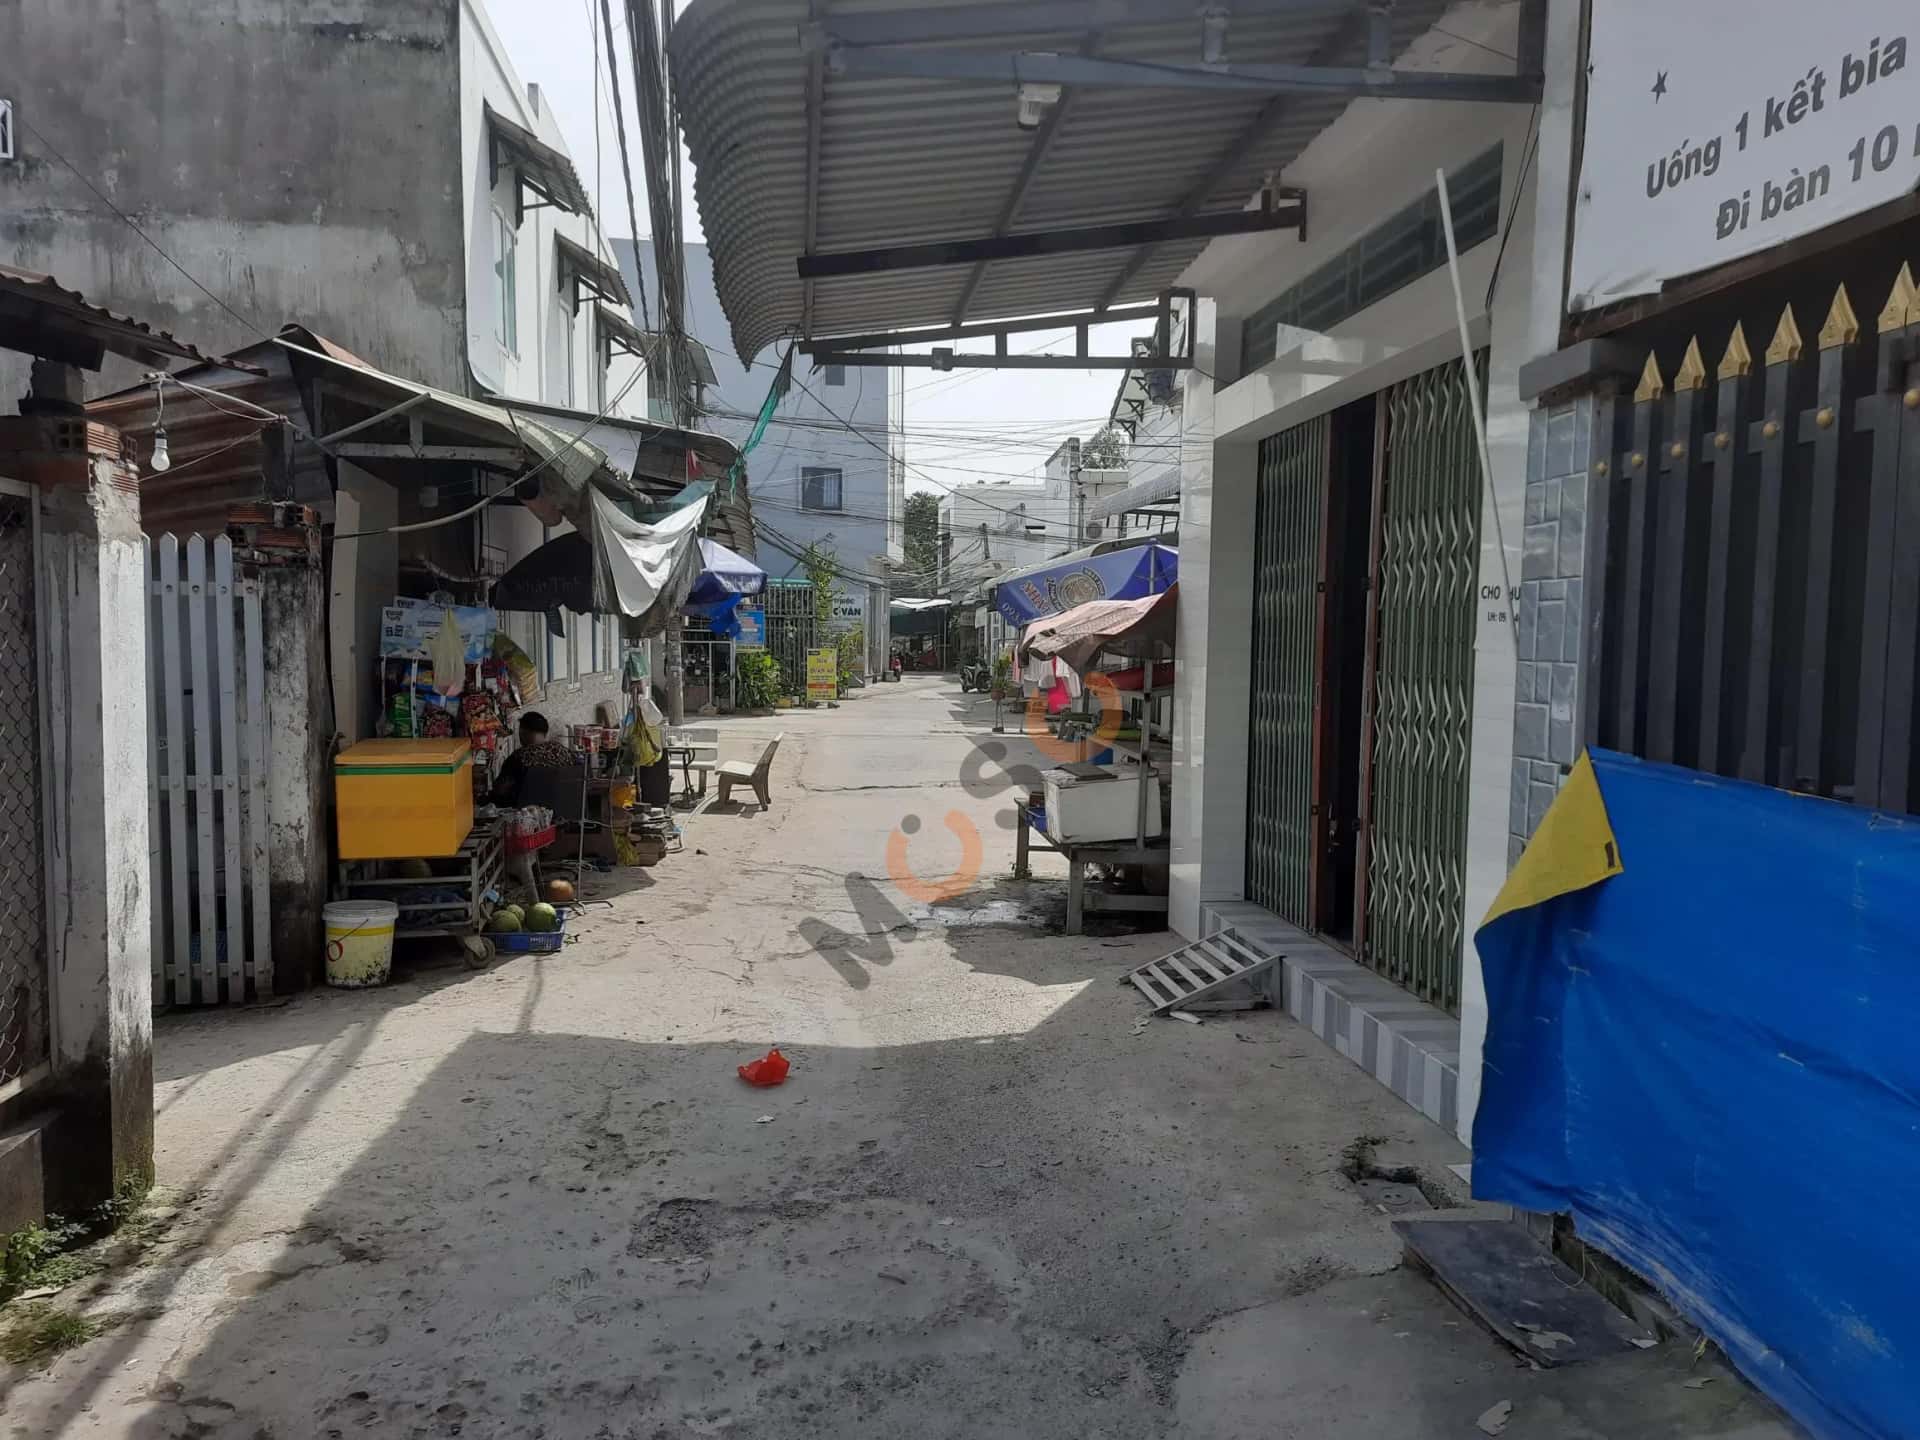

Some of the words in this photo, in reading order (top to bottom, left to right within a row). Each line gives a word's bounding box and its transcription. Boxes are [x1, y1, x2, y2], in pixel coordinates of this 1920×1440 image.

[1646, 136, 1722, 198] Uống
[1735, 111, 1749, 151] 1
[1763, 66, 1826, 138] kết
[1839, 36, 1907, 100] bia
[1716, 190, 1750, 241] Đi
[1760, 164, 1830, 221] bàn
[1848, 125, 1899, 182] 10
[1481, 586, 1501, 600] CHO
